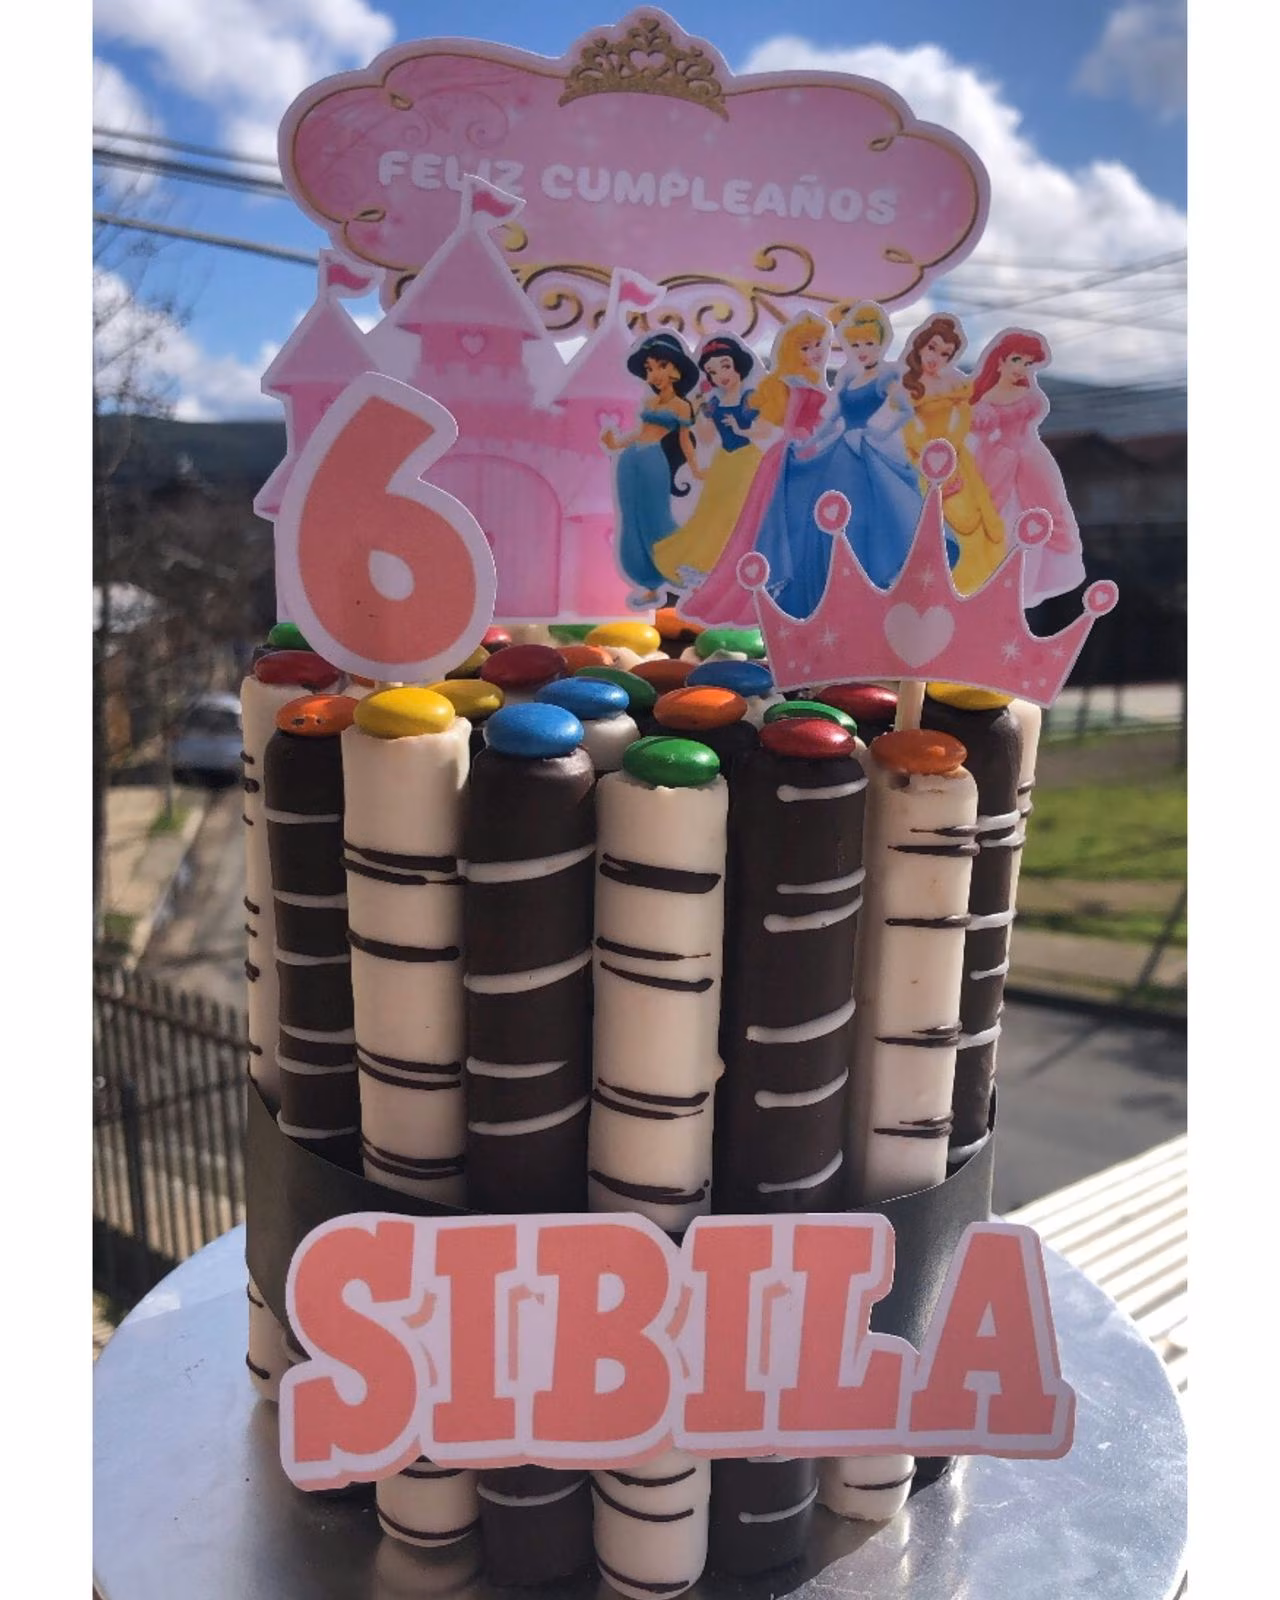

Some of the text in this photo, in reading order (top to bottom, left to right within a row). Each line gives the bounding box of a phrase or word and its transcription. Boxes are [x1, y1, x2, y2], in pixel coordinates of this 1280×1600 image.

[378, 150, 897, 225] FELIZ CUMPLEAÑOS
[298, 395, 477, 665] 6
[293, 1220, 1055, 1463] SIBILA
